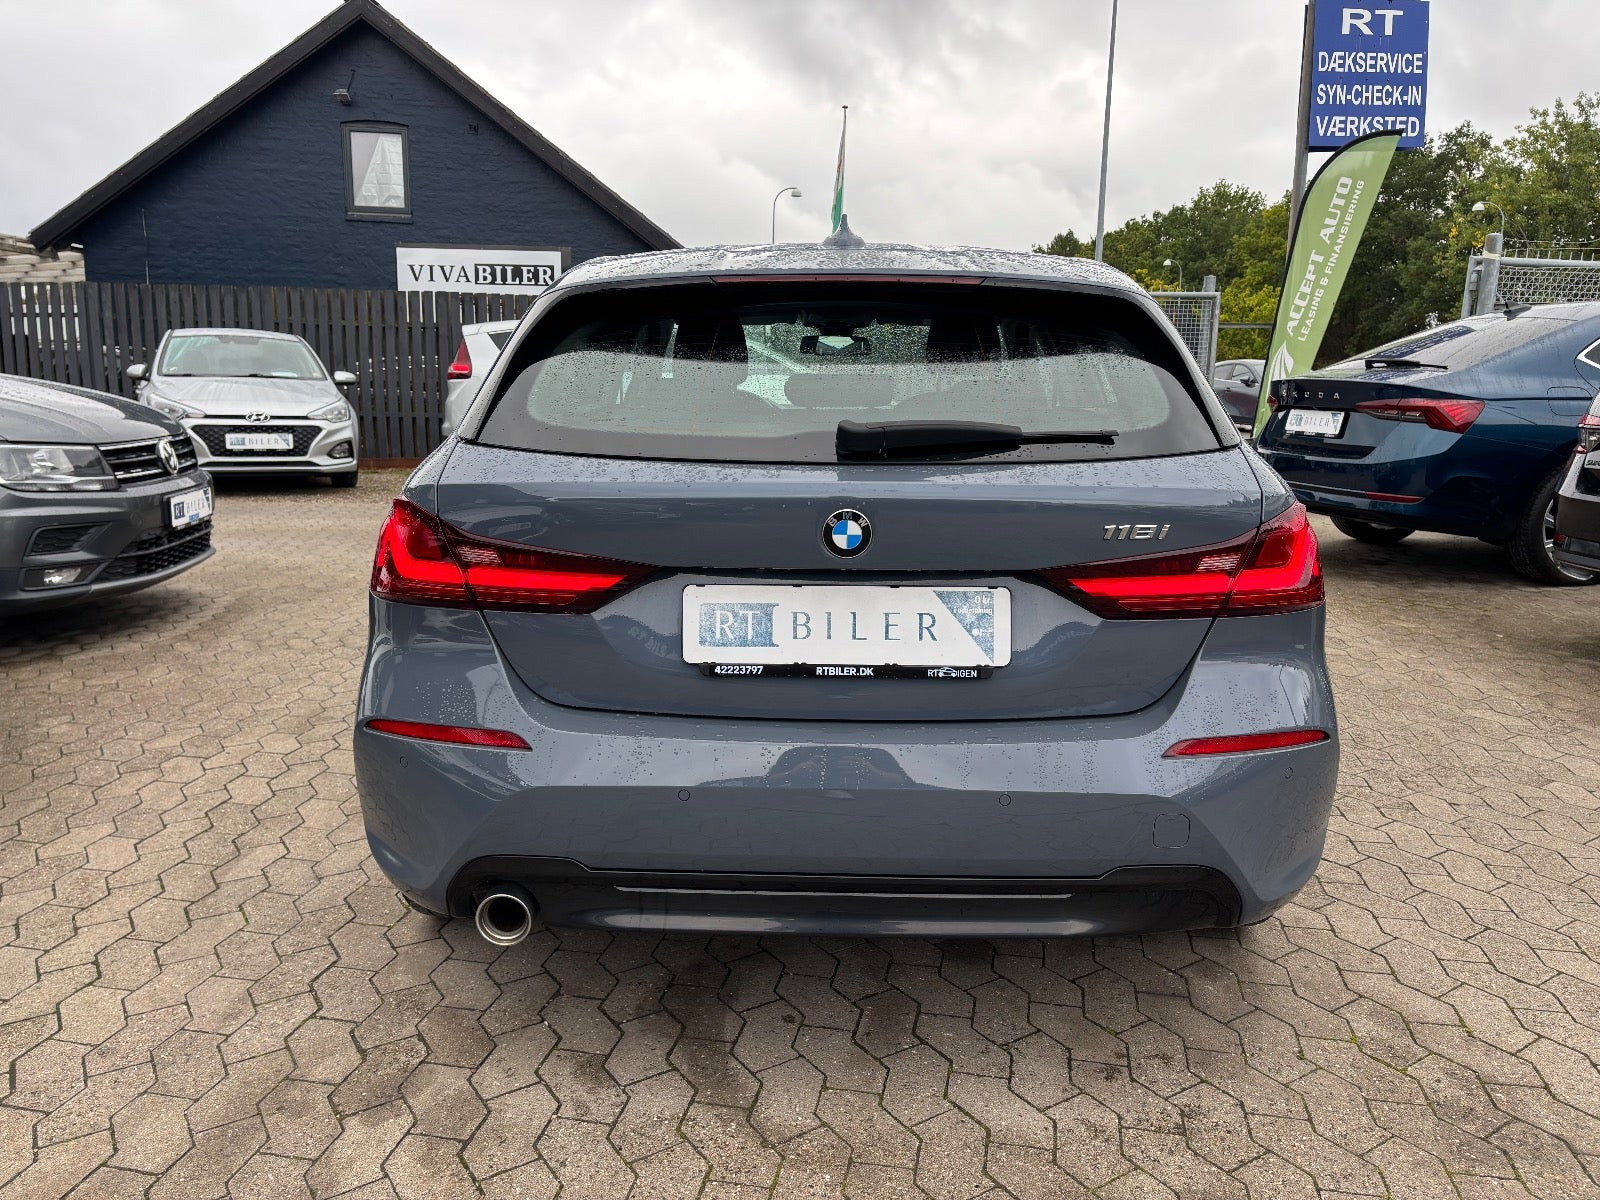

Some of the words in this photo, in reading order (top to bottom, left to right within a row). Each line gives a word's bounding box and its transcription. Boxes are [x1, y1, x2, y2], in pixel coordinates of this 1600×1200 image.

[1341, 7, 1404, 36] RT
[1317, 51, 1423, 74] DÆKSERVICE
[1316, 83, 1422, 106] SYN-CHECK-IN
[1315, 115, 1420, 137] VÆRKSTED
[1286, 249, 1324, 337] ACCEPT
[1319, 176, 1353, 245] AUTO
[1298, 287, 1324, 342] LEASING
[1324, 180, 1365, 275] FINANSIERING
[827, 510, 869, 528] BMW
[1103, 524, 1171, 540] 118i
[713, 609, 761, 641] RT
[791, 611, 938, 642] BILER
[714, 665, 764, 675] 42223797
[815, 666, 875, 676] RTBILER.DK
